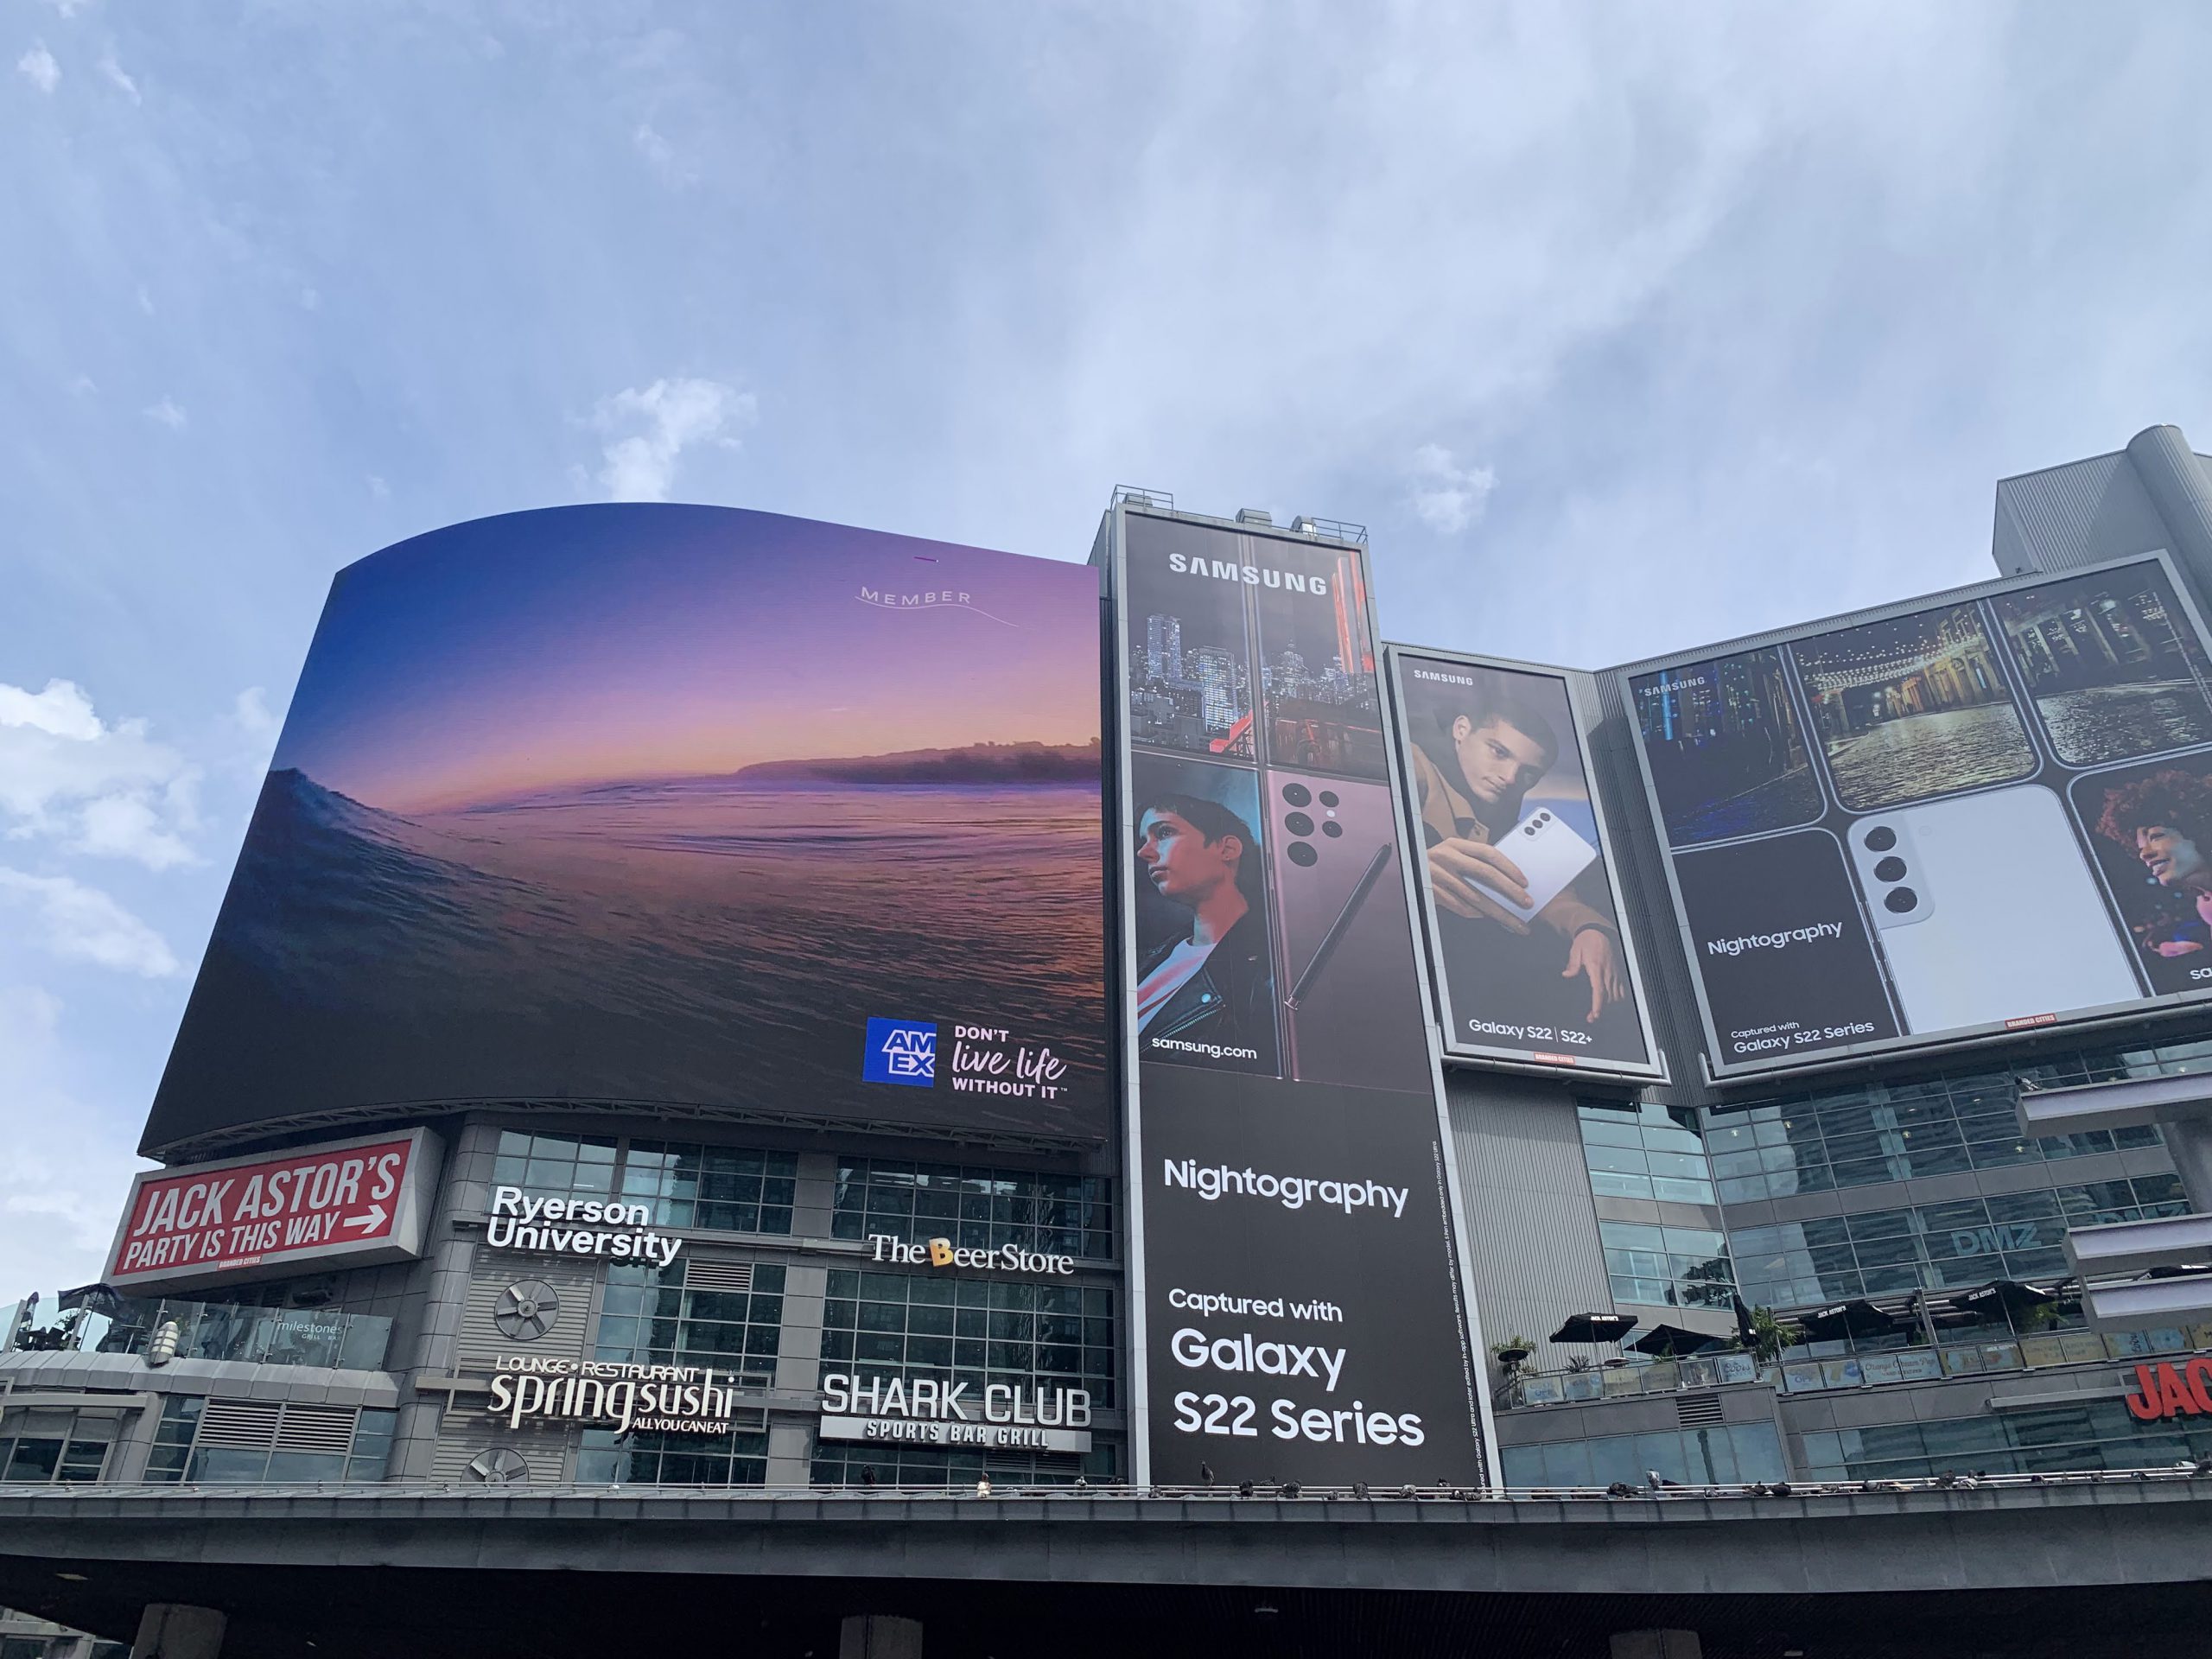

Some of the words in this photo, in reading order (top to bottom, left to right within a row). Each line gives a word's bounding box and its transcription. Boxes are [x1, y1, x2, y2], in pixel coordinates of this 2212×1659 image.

[1168, 552, 1327, 595] SAMSUNG
[861, 586, 970, 605] MEMBER
[1414, 670, 1473, 686] SAMSUNG
[1643, 677, 1705, 696] SAMSUNG
[1707, 921, 1842, 957] Nightography
[954, 1025, 1009, 1043] DON'T
[1469, 1019, 1524, 1040] Galaxy
[1527, 1026, 1554, 1040] S22
[1560, 1029, 1593, 1045] S22+
[1731, 1023, 1777, 1039] Captured
[1777, 1020, 1800, 1032] with
[1733, 1035, 1790, 1053] Galaxy
[1793, 1029, 1821, 1044] S22
[1823, 1021, 1875, 1039] Series
[951, 1040, 1010, 1074] live
[1016, 1046, 1067, 1084] life
[1151, 1036, 1258, 1059] samsung.com
[951, 1077, 1036, 1097] WITHOUT
[134, 1179, 236, 1237] JACK
[233, 1153, 401, 1222] ASTOR'S
[1164, 1158, 1409, 1218] Nightography
[492, 1185, 650, 1227] Ryerson
[123, 1232, 200, 1269] PARTY
[200, 1229, 226, 1258] IS
[228, 1219, 282, 1255] THIS
[284, 1211, 341, 1246] WAY
[486, 1217, 683, 1268] University
[868, 1233, 925, 1264] The
[1950, 1222, 2043, 1257] DMZ
[1168, 1287, 1285, 1318] Captured
[1289, 1299, 1344, 1322] with
[276, 1320, 343, 1335] milestones
[495, 1355, 569, 1375] LOUNGE
[581, 1361, 700, 1382] RESTAURANT
[1171, 1327, 1346, 1392] Galaxy
[822, 1373, 969, 1421] SHARK
[984, 1382, 1091, 1428] CLUB
[867, 1419, 940, 1441] SPORTS
[950, 1424, 988, 1444] BAR
[996, 1426, 1050, 1447] GRILL
[1173, 1390, 1258, 1437] S22
[1270, 1398, 1425, 1446] Series
